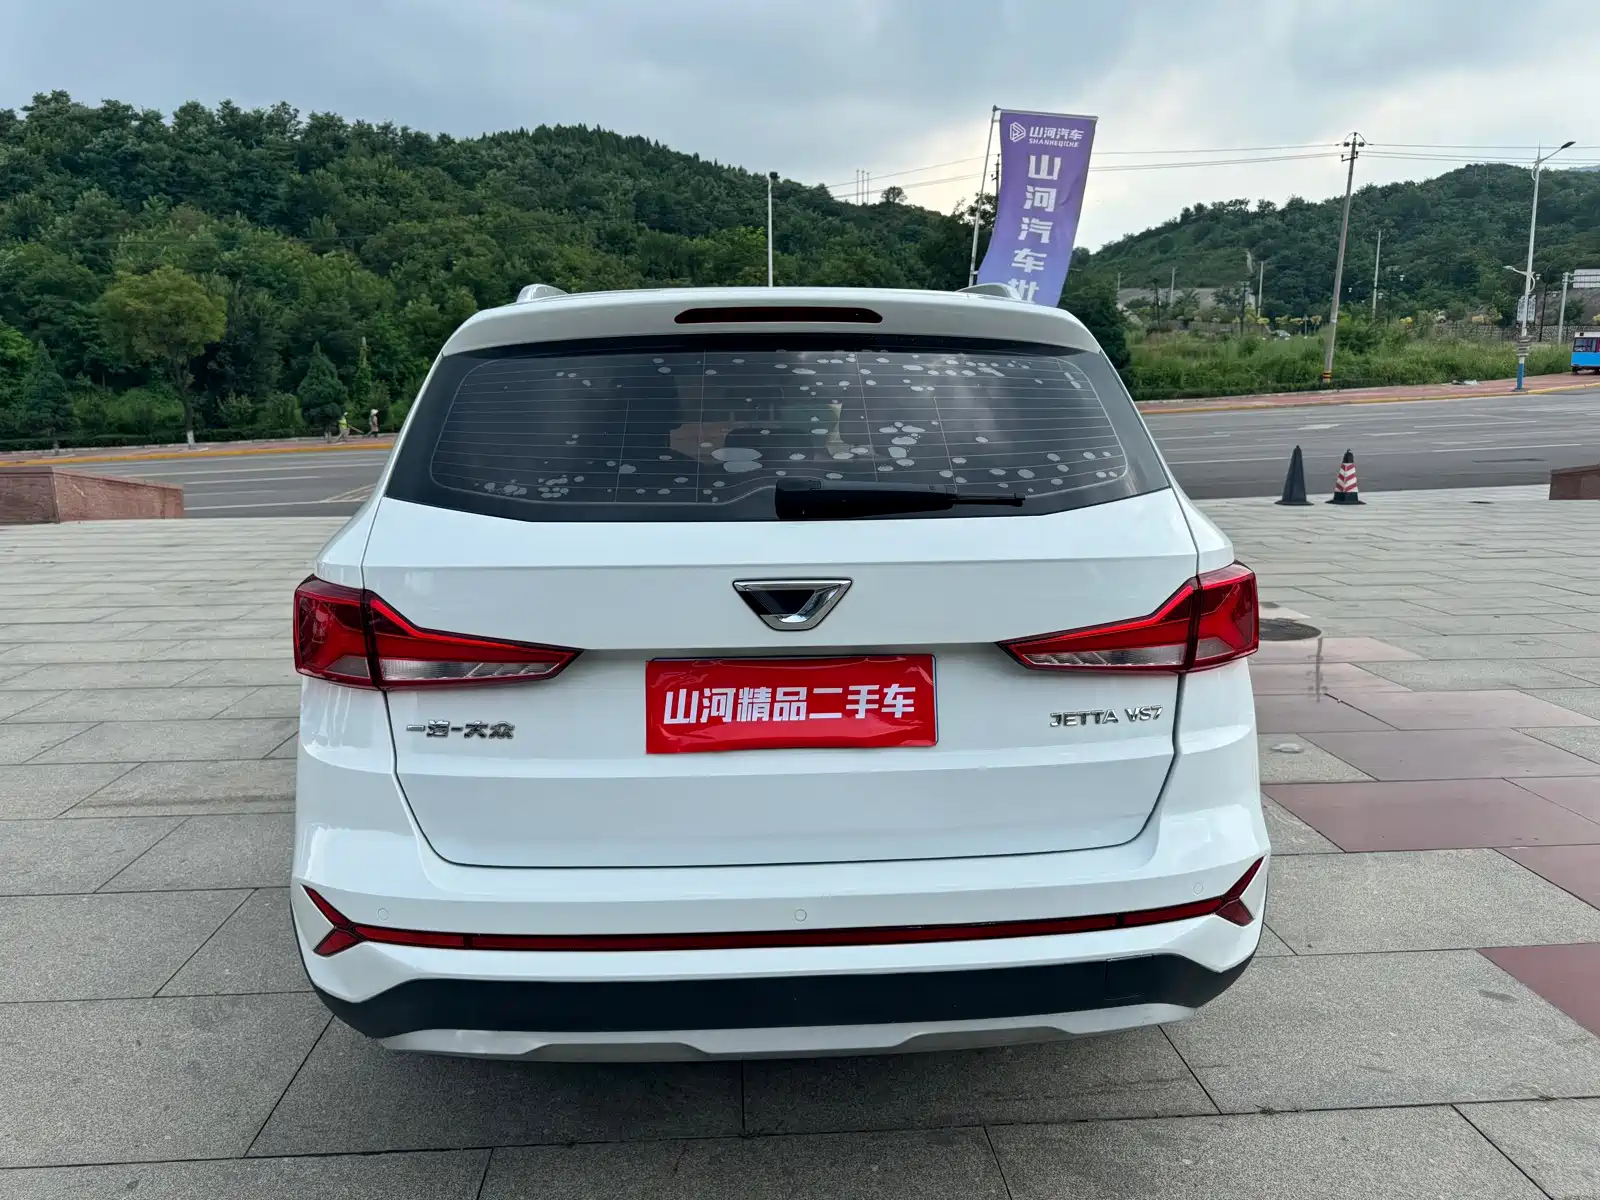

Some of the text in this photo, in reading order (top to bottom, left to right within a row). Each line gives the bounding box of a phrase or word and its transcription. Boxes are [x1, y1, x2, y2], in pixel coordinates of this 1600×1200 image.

[1029, 126, 1085, 140] 山河汽车
[1028, 138, 1080, 148] SHANHEQICHE
[663, 683, 916, 724] 山河精品二手车
[1049, 704, 1164, 728] JETTA VS7
